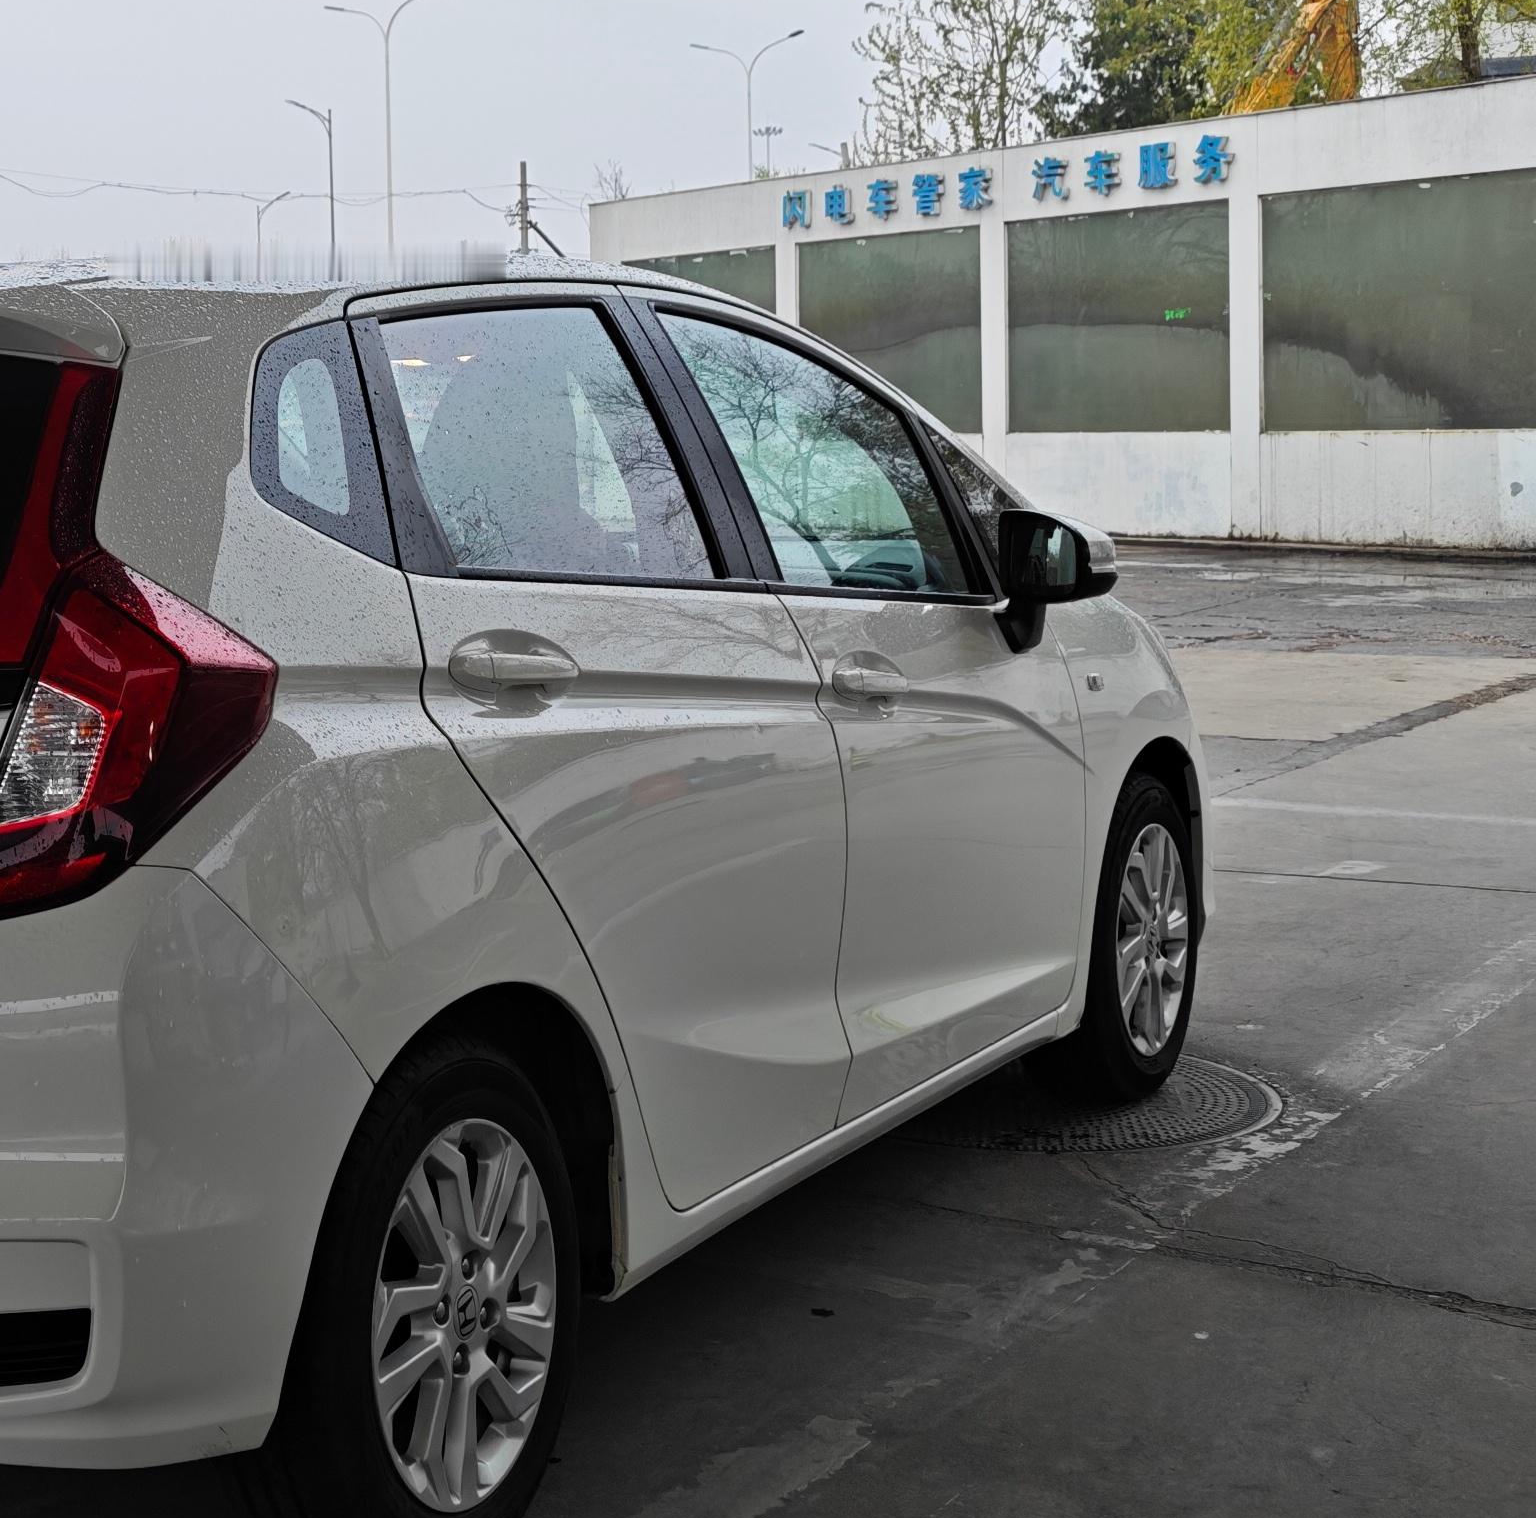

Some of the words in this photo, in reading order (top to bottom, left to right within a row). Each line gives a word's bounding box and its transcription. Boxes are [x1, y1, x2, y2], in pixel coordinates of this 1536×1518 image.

[782, 165, 996, 230] 闪电车管家
[1030, 134, 1236, 202] 汽车服务
